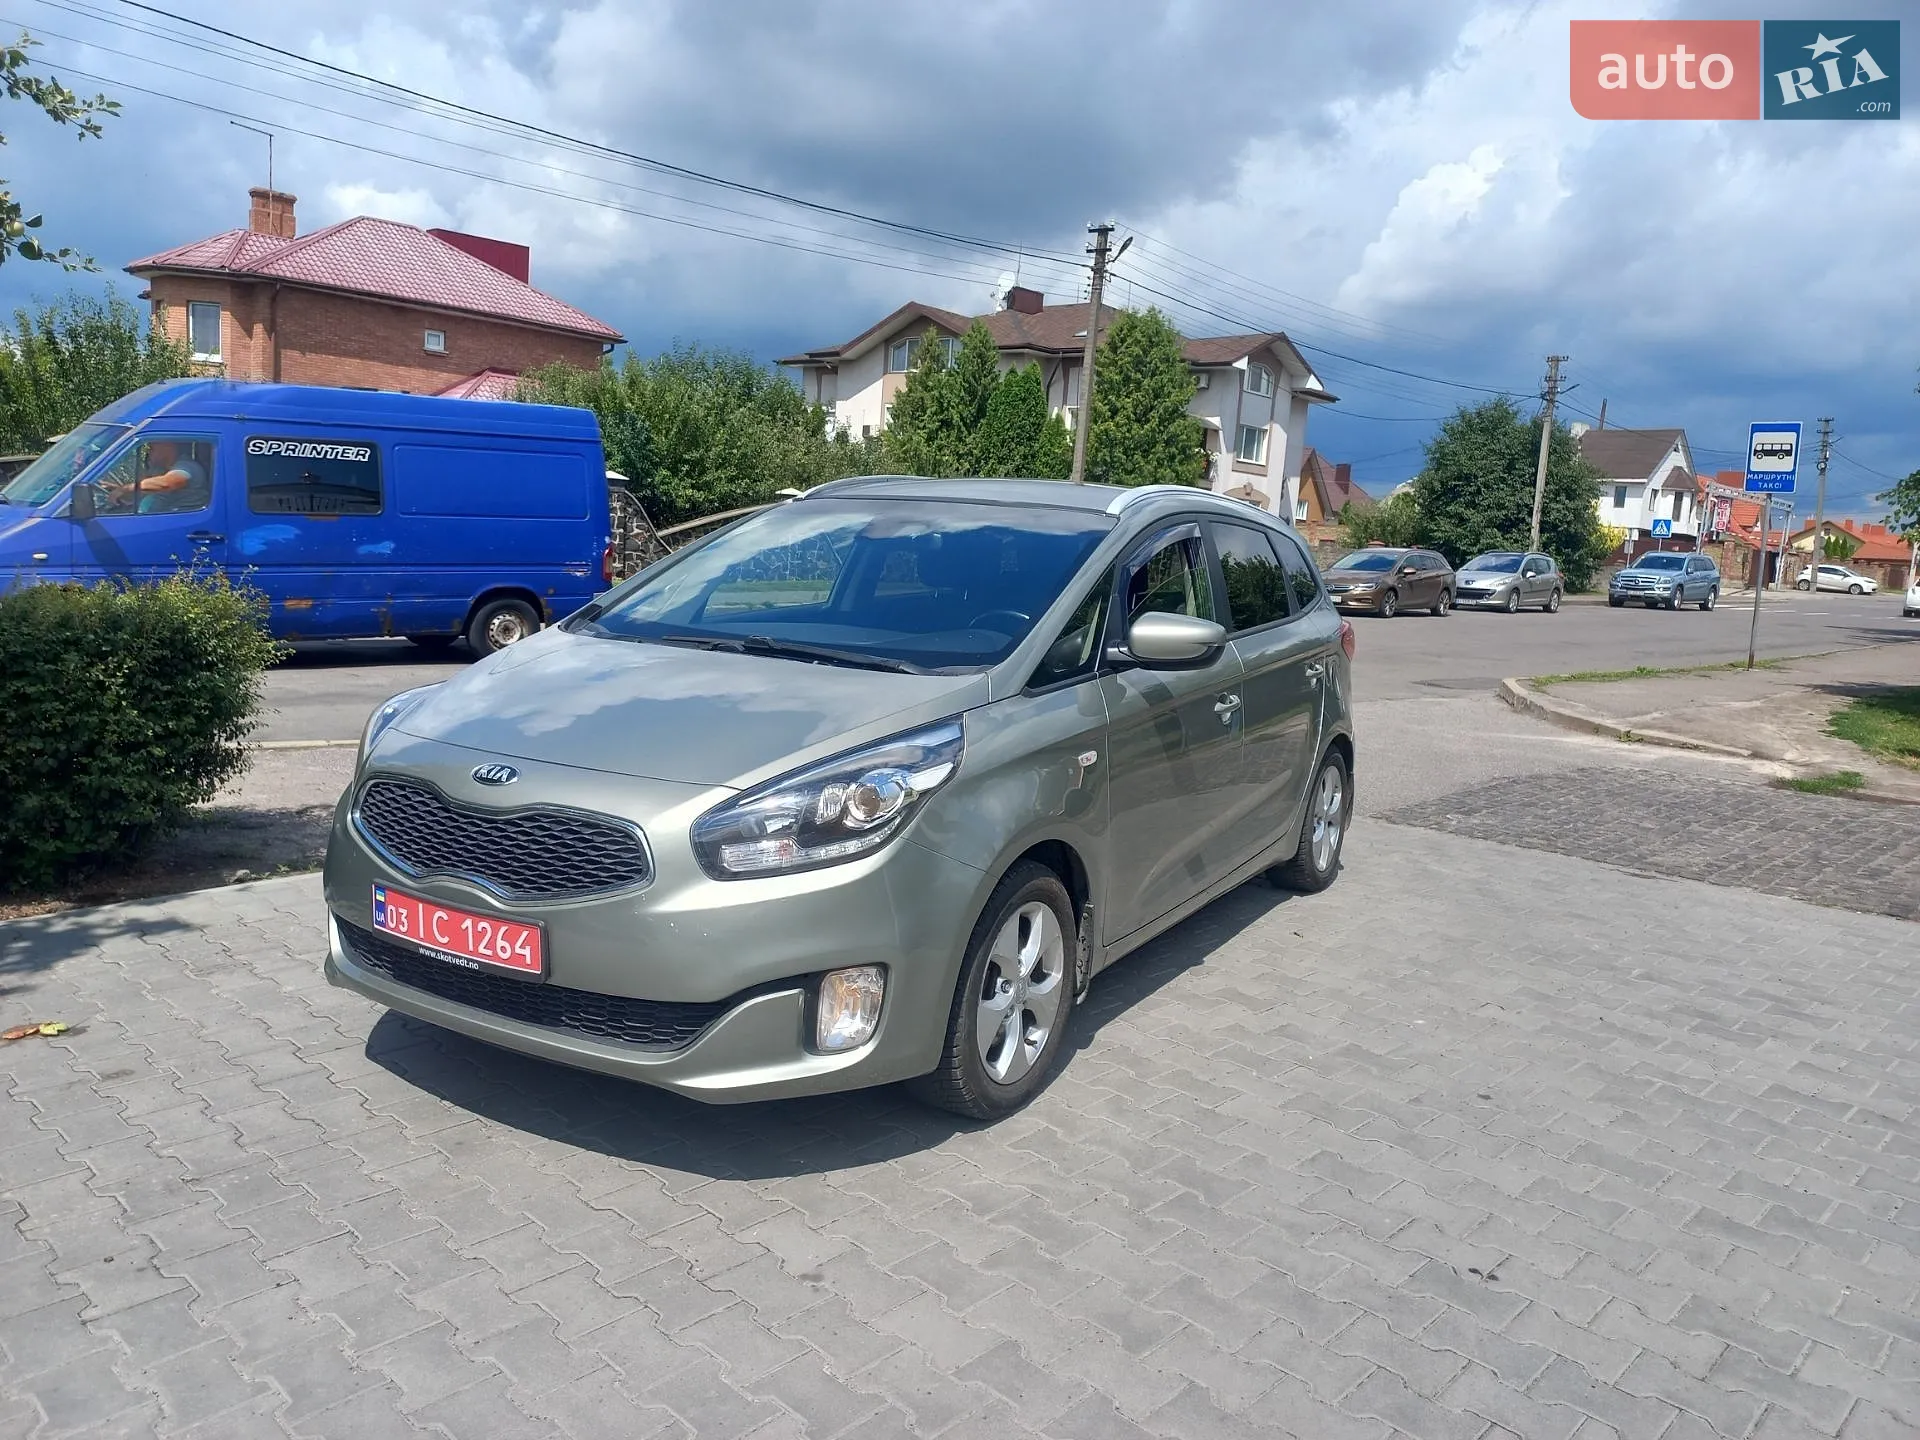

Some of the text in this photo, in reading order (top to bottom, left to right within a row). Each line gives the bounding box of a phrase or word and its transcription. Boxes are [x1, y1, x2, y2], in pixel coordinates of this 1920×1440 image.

[247, 439, 371, 462] SPRINTER
[1747, 473, 1795, 481] МАРШРУТНІ
[476, 765, 510, 782] KIA
[375, 910, 385, 923] UA
[386, 904, 409, 933] 03
[460, 918, 531, 965] 1264
[418, 946, 479, 971] www.skotvedt.no
